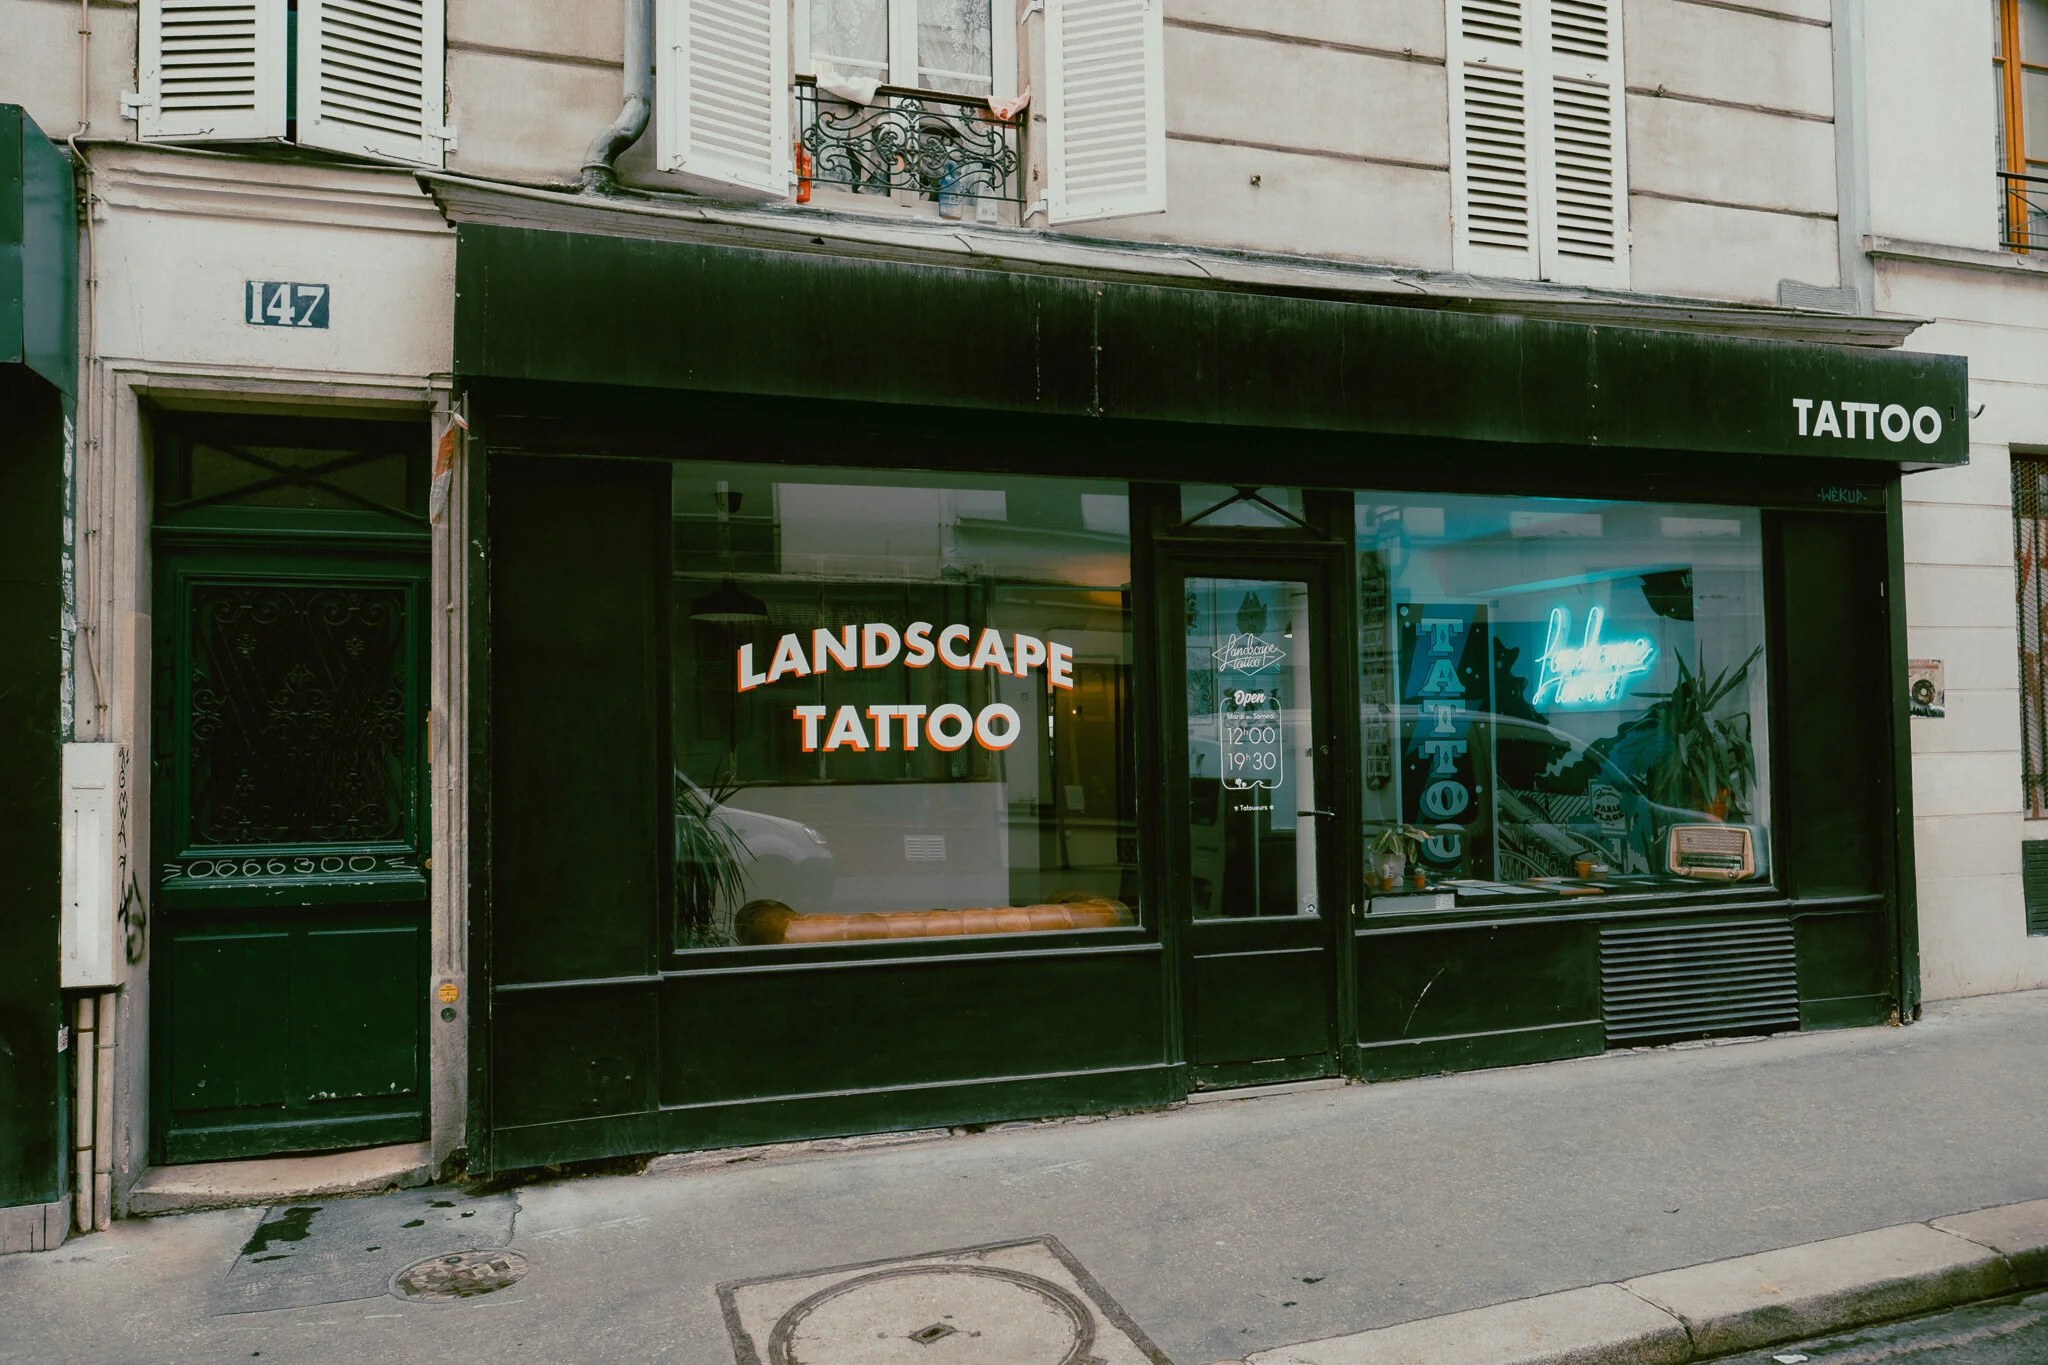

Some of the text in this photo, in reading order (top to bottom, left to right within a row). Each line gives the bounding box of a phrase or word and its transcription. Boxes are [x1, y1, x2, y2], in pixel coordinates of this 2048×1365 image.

[249, 281, 326, 327] 147
[1792, 398, 1942, 444] TATTOO
[737, 621, 1074, 693] LANDSCAPE
[1234, 689, 1266, 706] Open
[1227, 712, 1245, 720] Mardi
[1253, 712, 1275, 720] Samedi
[792, 702, 1021, 753] TATTOO
[1227, 727, 1276, 745] 12h00
[1228, 752, 1277, 770] 19h30
[1240, 804, 1268, 812] Tatoueurs
[188, 856, 376, 877] 0666300
